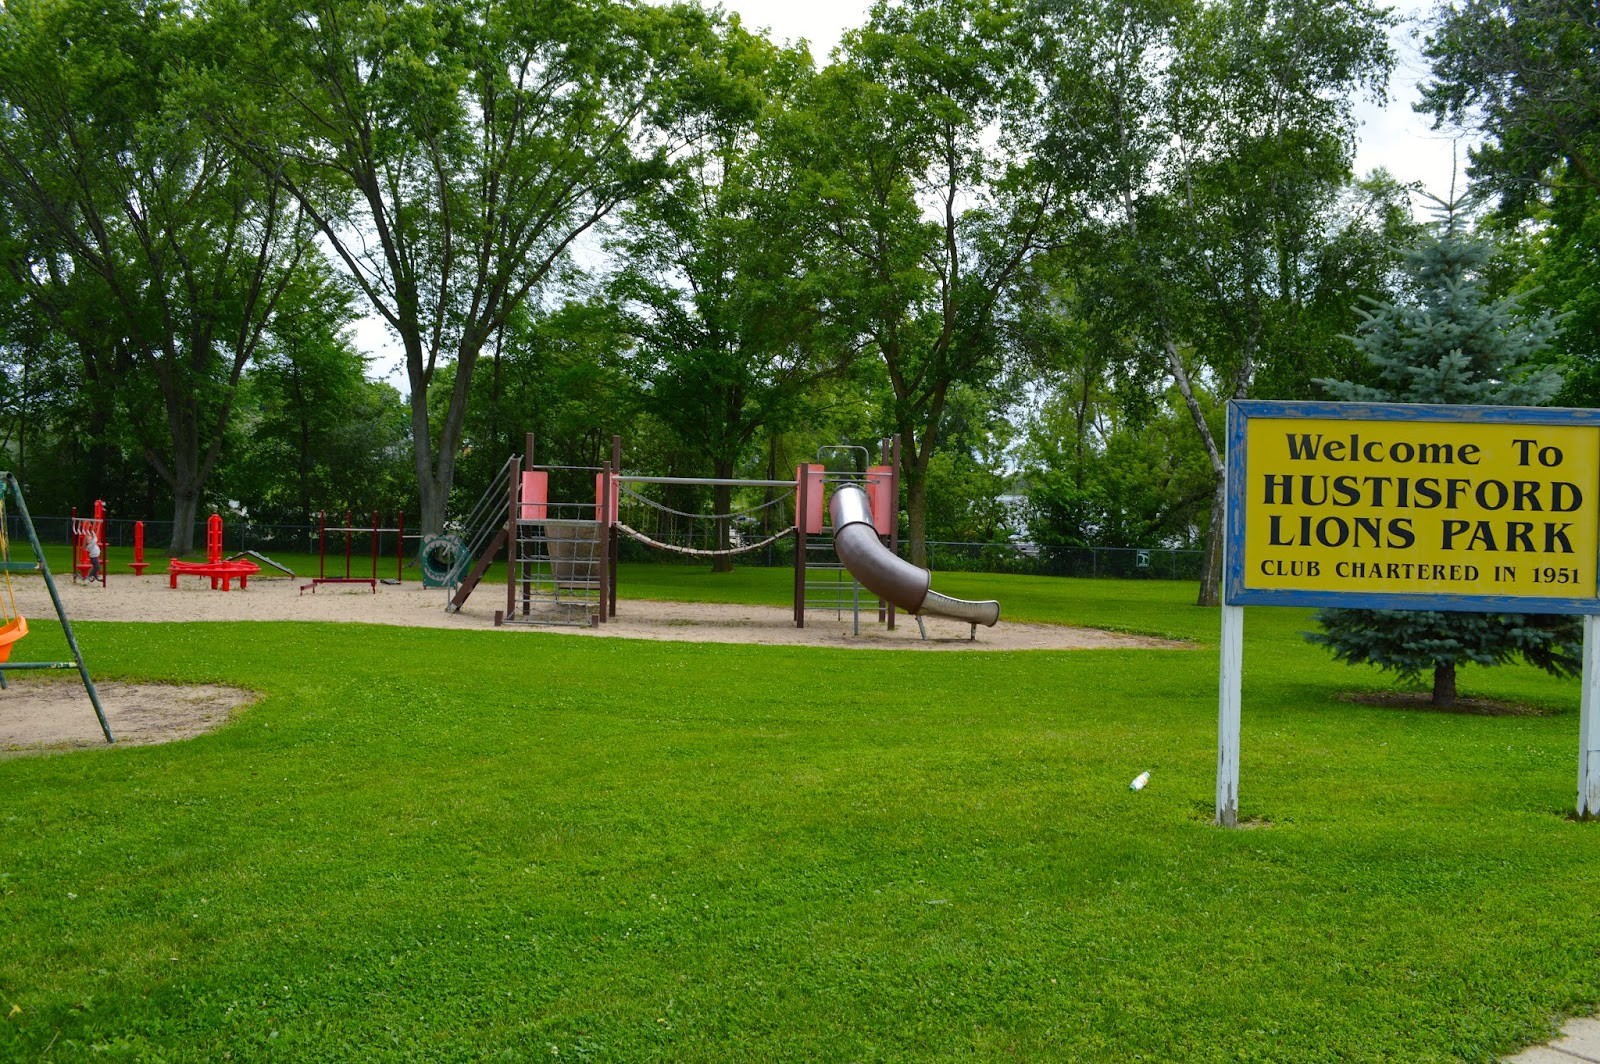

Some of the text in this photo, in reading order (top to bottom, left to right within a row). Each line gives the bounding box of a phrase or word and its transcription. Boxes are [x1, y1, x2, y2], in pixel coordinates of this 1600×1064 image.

[1285, 433, 1563, 467] Welcome To
[1262, 474, 1583, 512] HUSTISFORD
[1268, 515, 1575, 554] LIONS PARK
[1260, 559, 1581, 584] CLUB CHARTERED IN 1951
